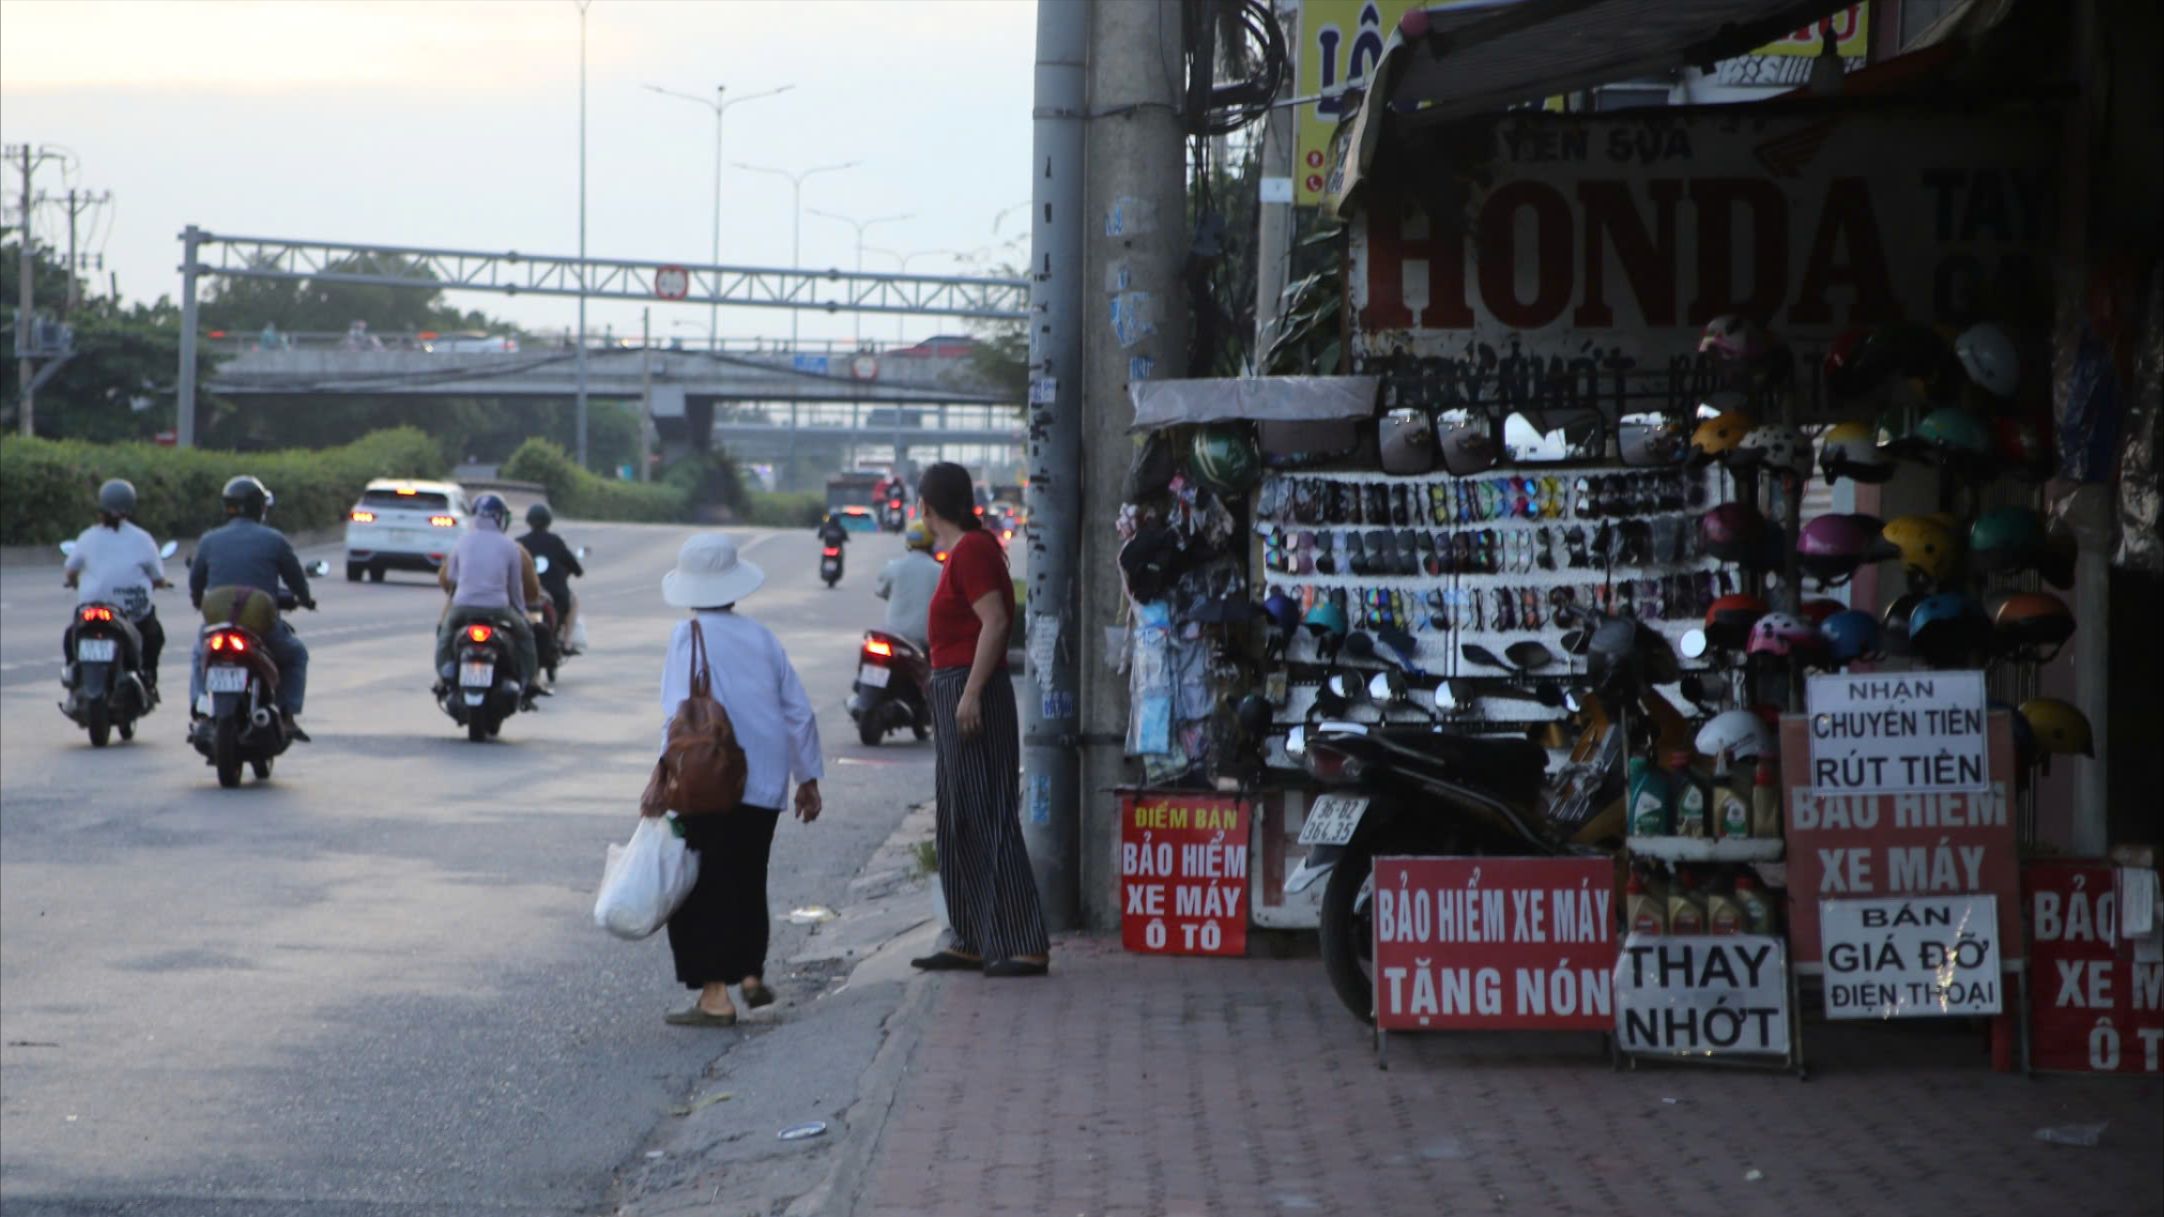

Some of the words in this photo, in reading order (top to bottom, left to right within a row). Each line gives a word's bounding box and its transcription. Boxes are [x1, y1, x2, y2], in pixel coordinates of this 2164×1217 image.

[1359, 174, 1906, 329] HONDA
[1848, 678, 1934, 703] NHẬN
[1814, 704, 1917, 739] CHUYỂN
[1924, 703, 1981, 736] TIỀN
[1816, 749, 1888, 787] RÚT
[1899, 748, 1982, 785] TIỀN
[1135, 801, 1188, 828] ĐIỂM
[1195, 806, 1238, 830] BÁN
[1123, 830, 1173, 877] BẢO
[1181, 829, 1247, 878] HIỂM
[1818, 847, 1873, 893] XE
[1888, 837, 1986, 892] MÁY
[1126, 884, 1165, 916] XE
[1176, 880, 1241, 917] MÁY
[1378, 870, 1431, 943] BẢO
[1438, 866, 1505, 943] HIỂM
[1512, 888, 1546, 943] XE
[1553, 877, 1610, 943] MÁY
[1862, 904, 1950, 927] BÁN
[1145, 917, 1167, 949] Ô
[1180, 919, 1221, 950] TÔ
[1828, 933, 1906, 973] GIÁ
[1918, 932, 1989, 971] ĐỠ
[1626, 945, 1771, 988] THAY
[2055, 959, 2114, 1008] XE
[1384, 957, 1502, 1025] TẶNG
[1515, 957, 1612, 1016] NÓN
[1831, 980, 1897, 1012] ĐIỆN
[1906, 981, 1994, 1010] THOẠI
[1625, 996, 1779, 1047] NHỚT
[2089, 1016, 2121, 1071] Ô
